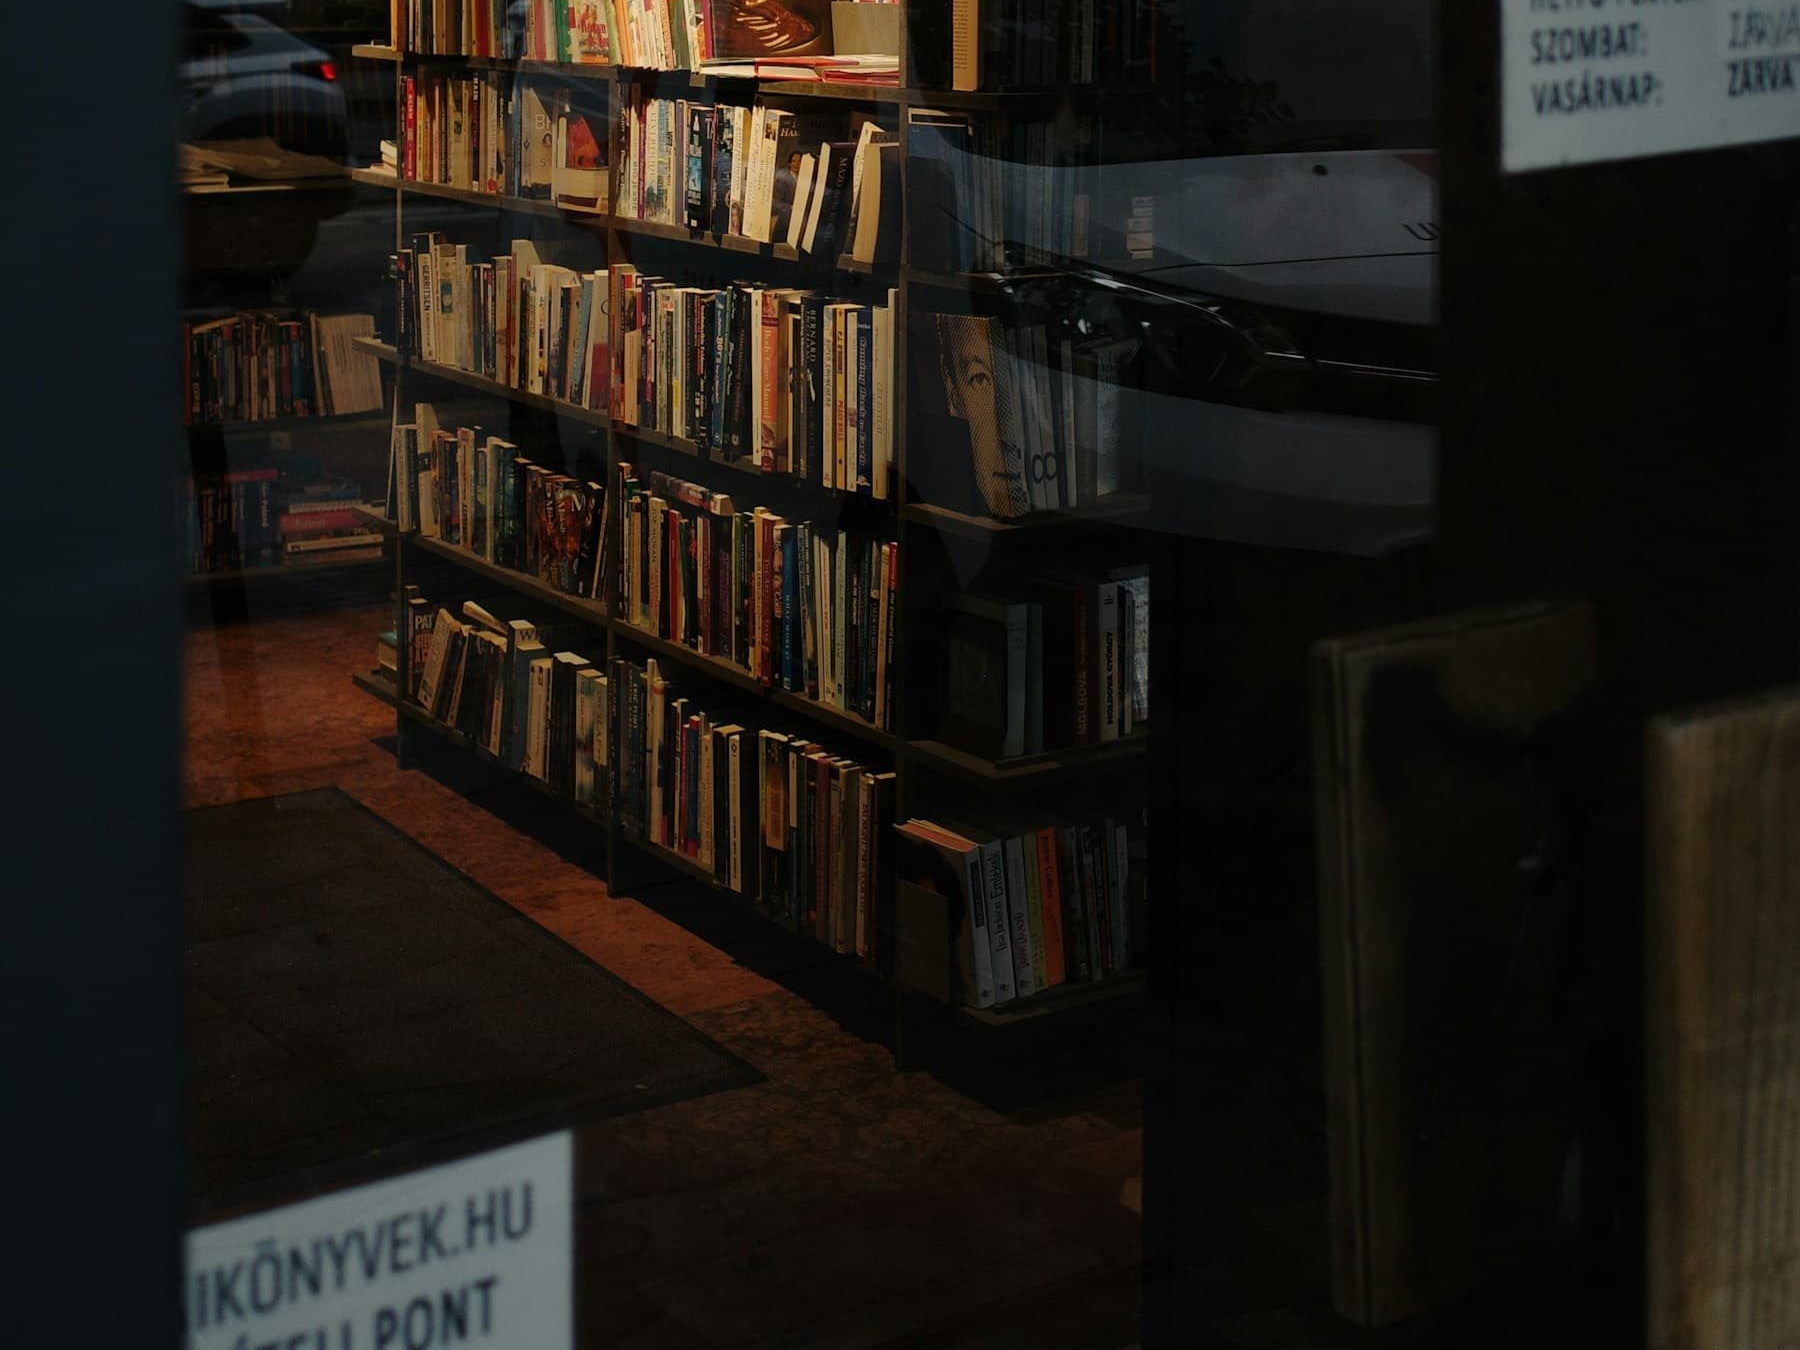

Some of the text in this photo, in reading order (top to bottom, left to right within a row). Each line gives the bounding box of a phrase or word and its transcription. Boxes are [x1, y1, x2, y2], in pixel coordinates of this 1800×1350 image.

[1531, 22, 1647, 64] SZOMBAT:
[1531, 72, 1663, 115] VASÁRNAP:
[422, 265, 431, 311] GERRITSEN
[1078, 670, 1087, 735] MOLDOVA
[373, 1276, 497, 1350] PONT
